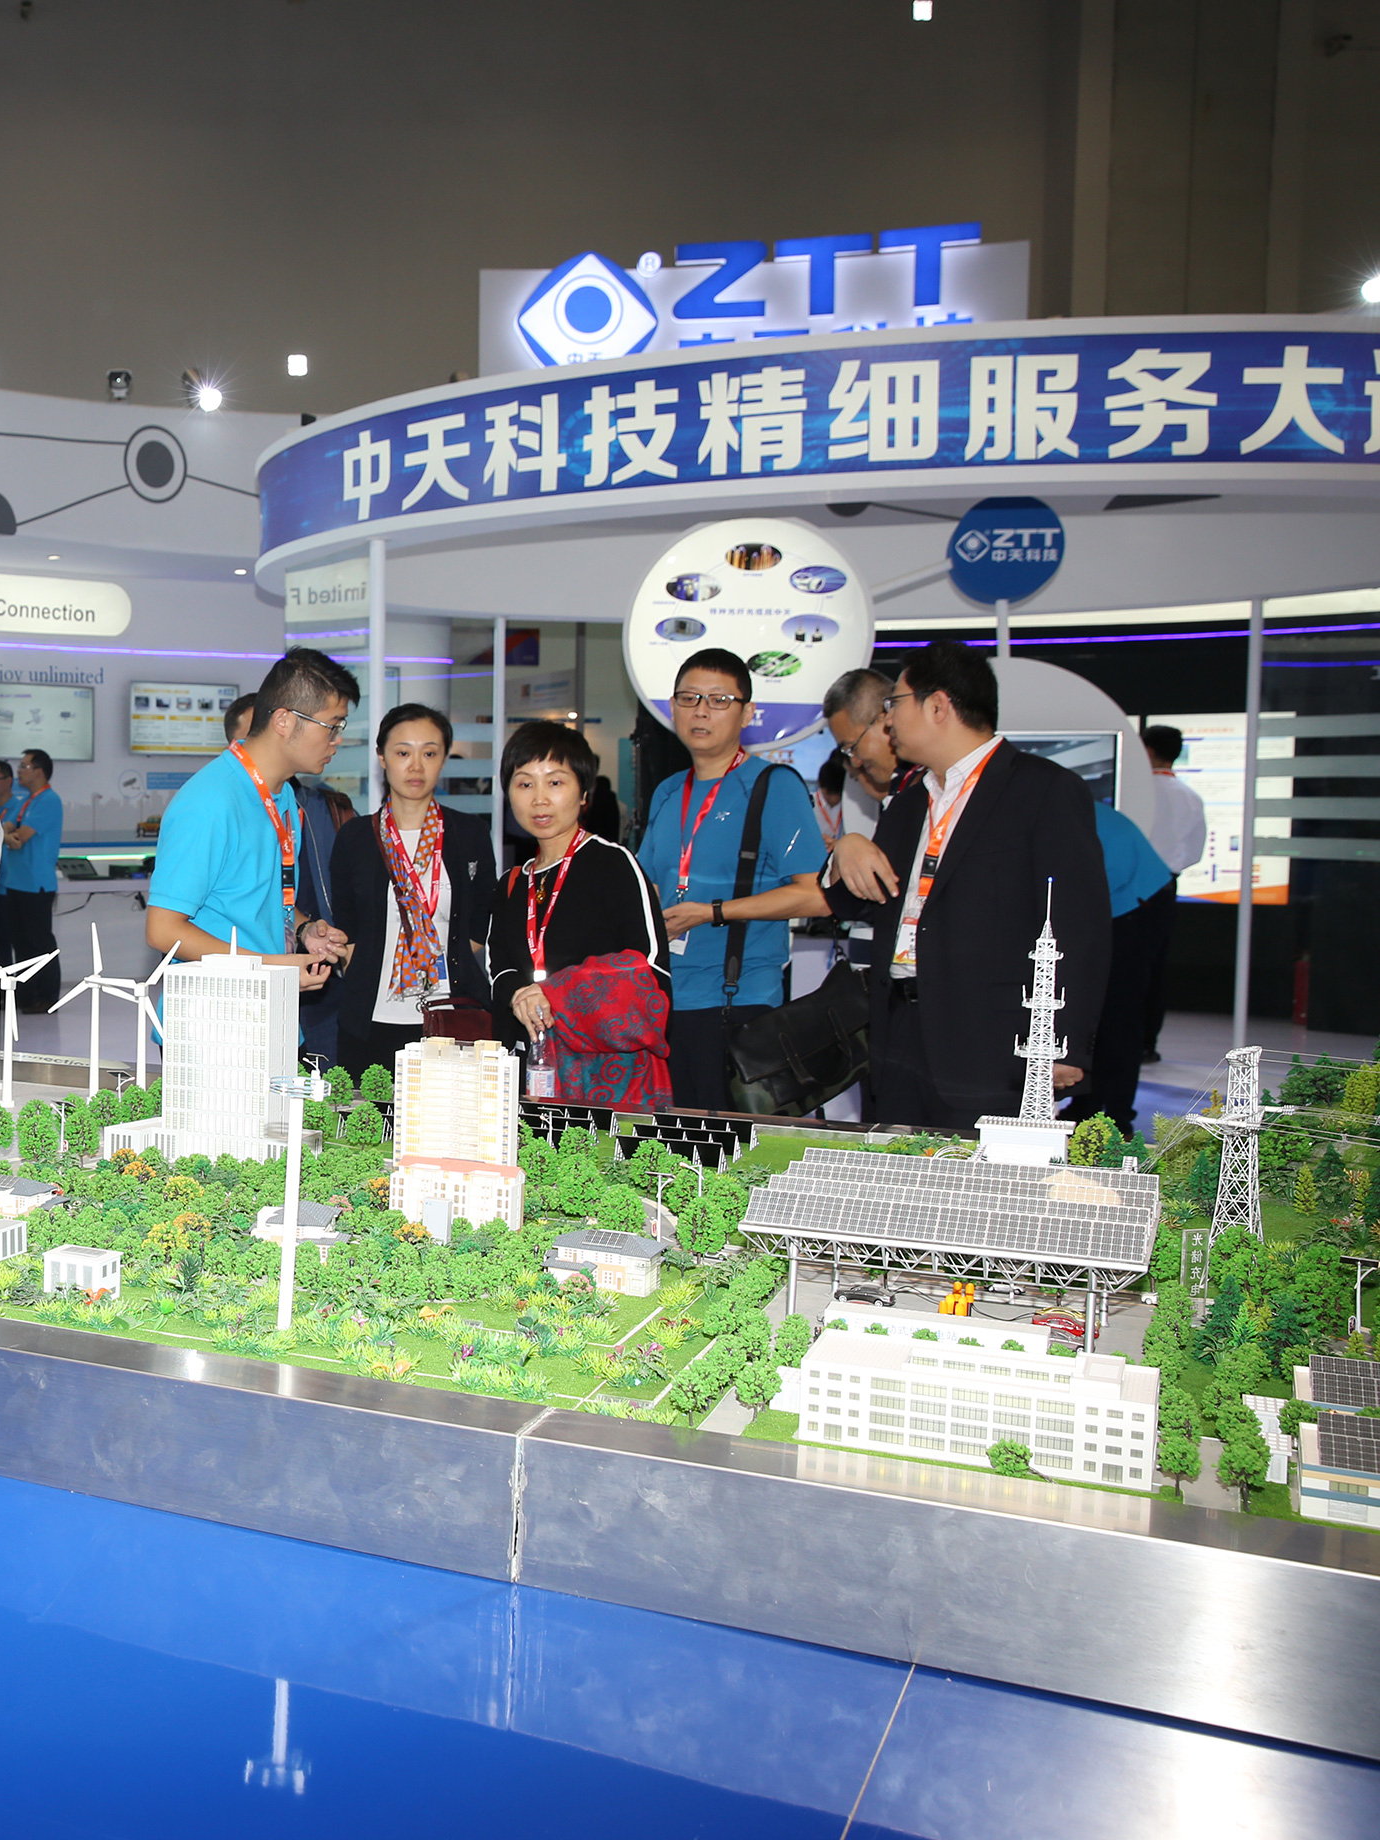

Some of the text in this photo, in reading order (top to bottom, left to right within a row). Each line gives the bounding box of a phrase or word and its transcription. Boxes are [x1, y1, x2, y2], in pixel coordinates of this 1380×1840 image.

[672, 221, 981, 319] ZTT
[992, 528, 1061, 548] ZTT
[991, 548, 1058, 562] 中天科技
[28, 665, 104, 684] unlimited
